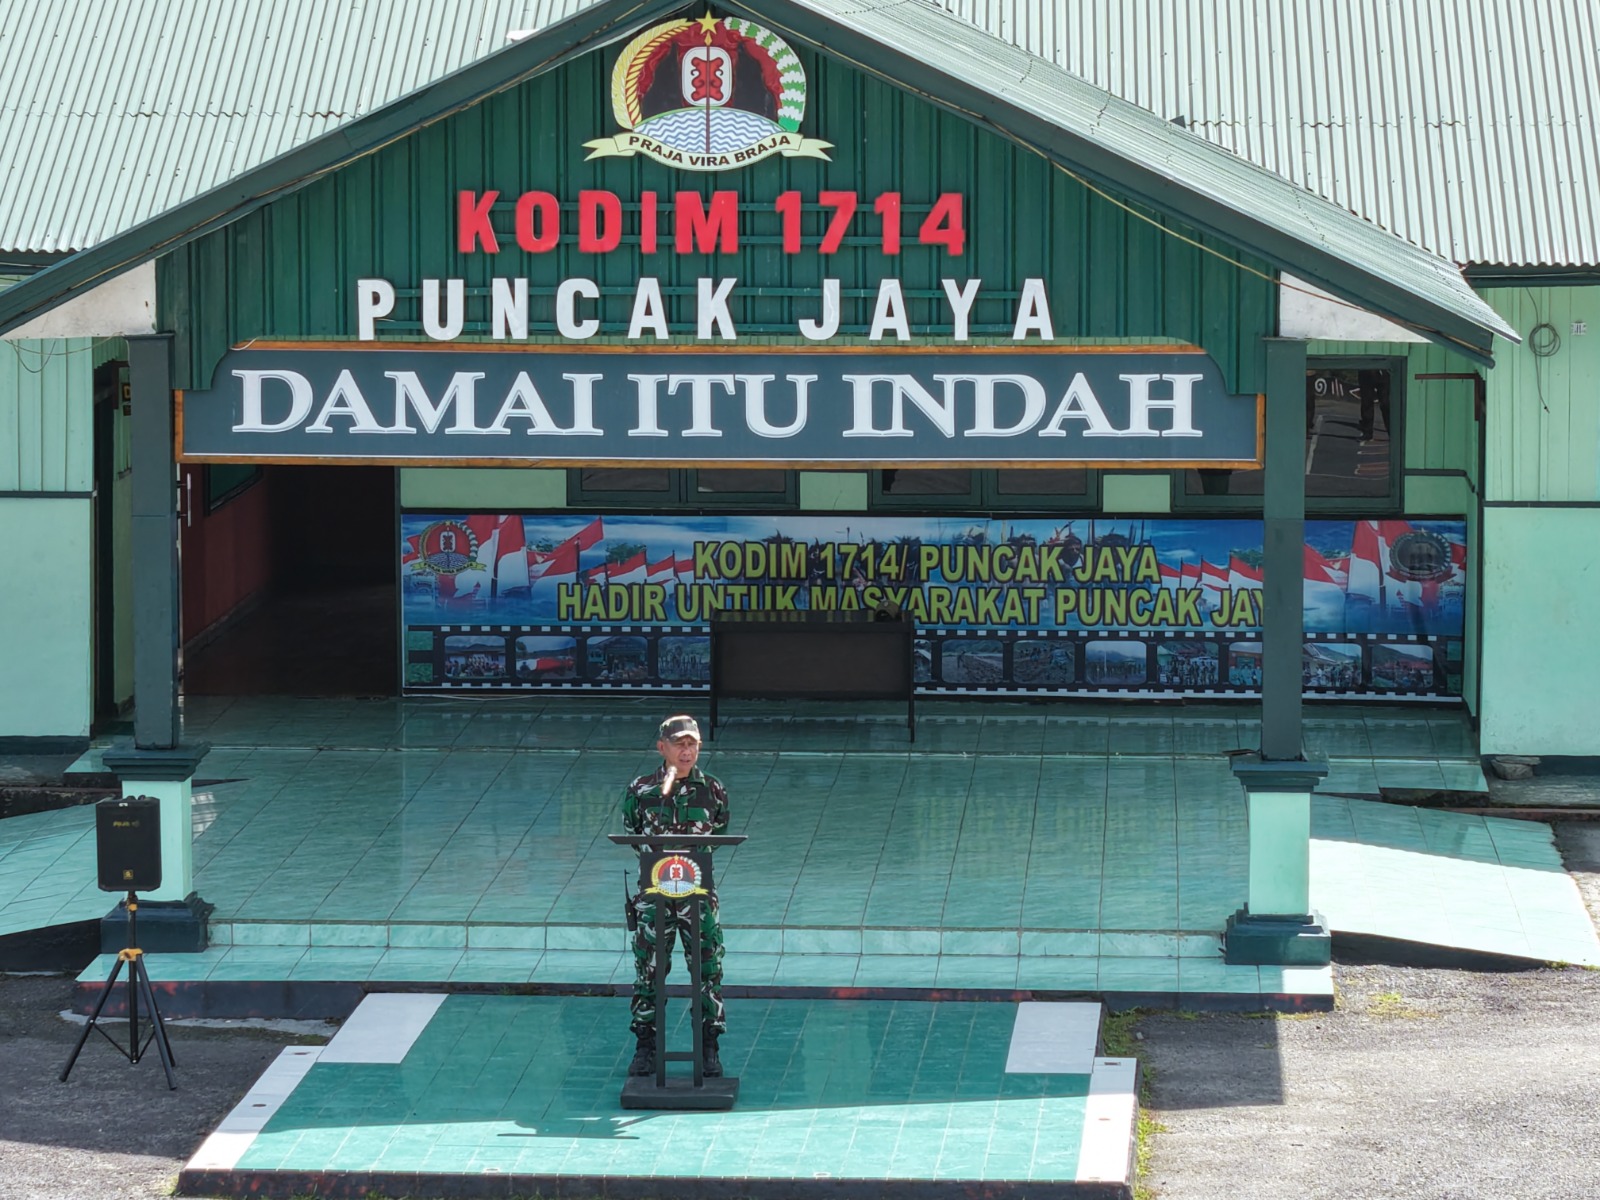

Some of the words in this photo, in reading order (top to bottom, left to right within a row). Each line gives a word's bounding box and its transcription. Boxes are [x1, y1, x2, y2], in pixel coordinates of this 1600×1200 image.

[628, 136, 683, 164] PRAJA
[689, 155, 730, 167] VIRA
[734, 135, 791, 163] BRAJA
[458, 190, 739, 255] KODIM
[775, 190, 966, 256] 1714
[357, 277, 738, 342] PUNCAK
[798, 278, 1055, 342] JAYA
[231, 368, 604, 436] DAMAI
[627, 373, 819, 438] ITU
[842, 372, 1204, 438] INDAH
[694, 541, 809, 581] KODIM
[819, 542, 909, 582] 1714/
[919, 544, 1066, 584] PUNCAK
[1073, 545, 1163, 584] JAYA
[557, 583, 668, 622] HADIR
[1055, 586, 1204, 628] PUNCAK
